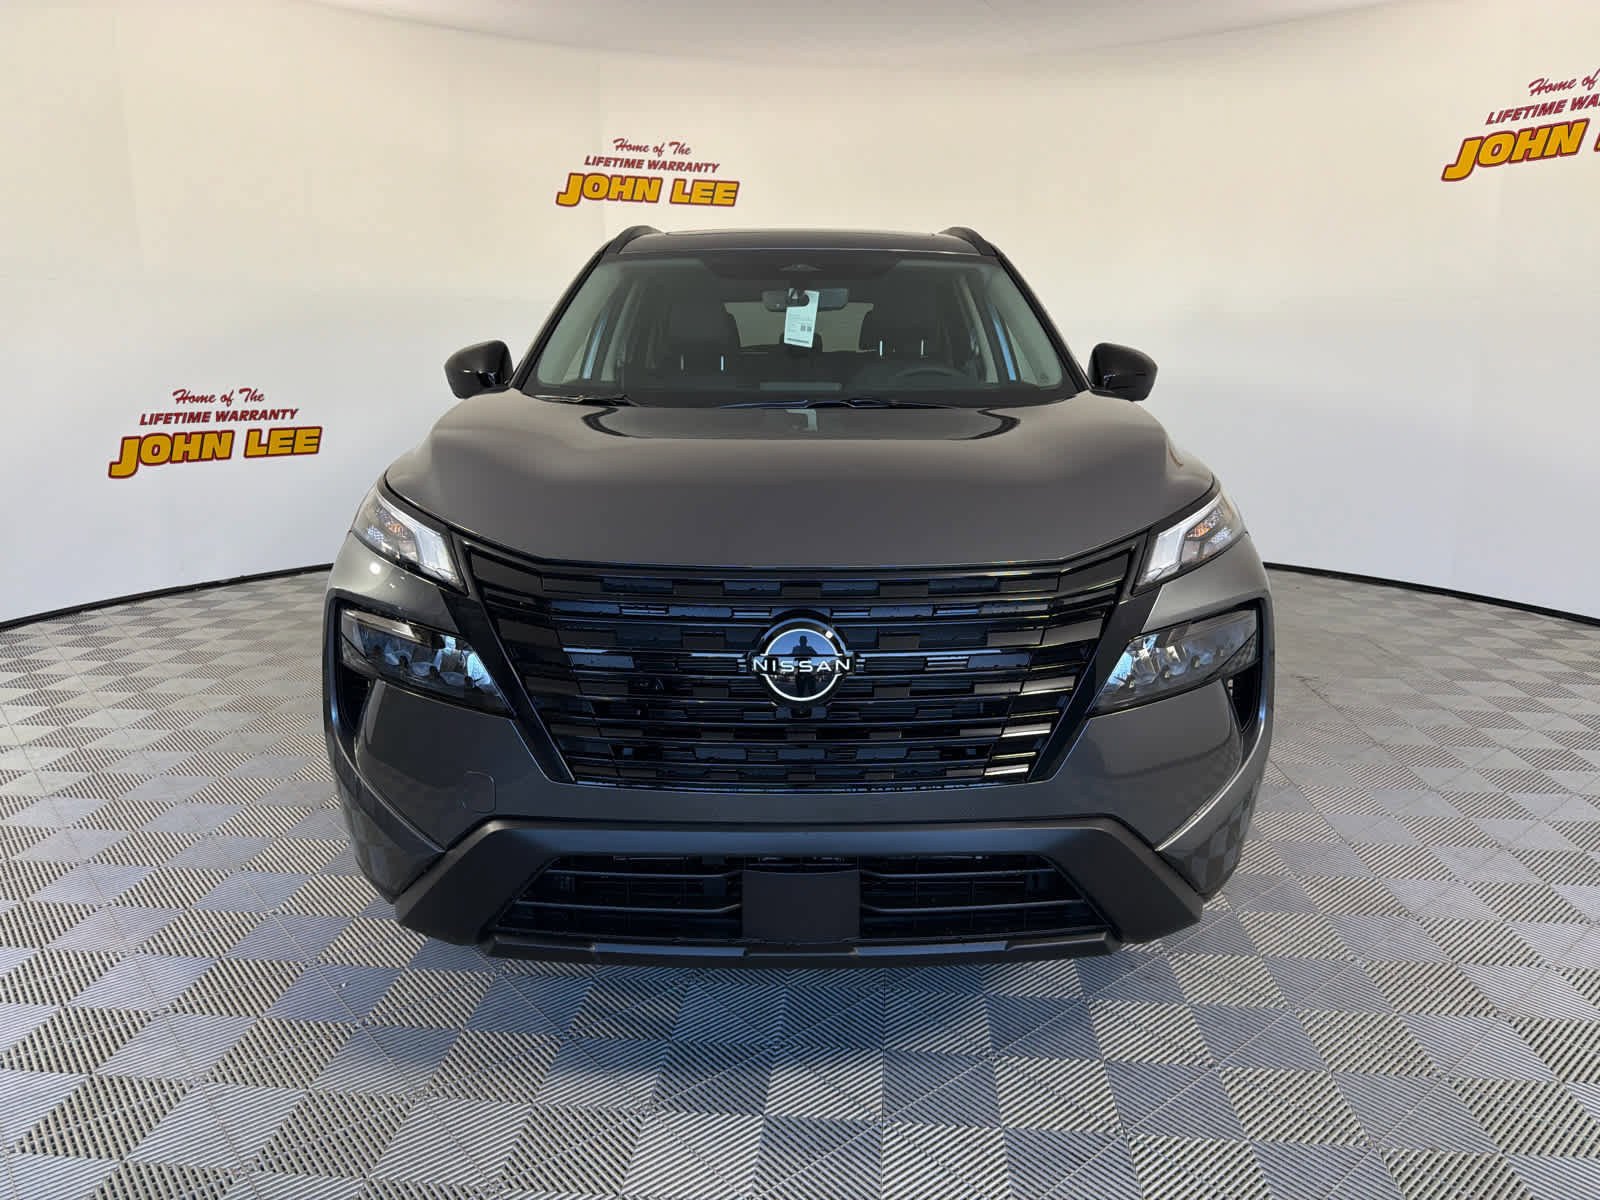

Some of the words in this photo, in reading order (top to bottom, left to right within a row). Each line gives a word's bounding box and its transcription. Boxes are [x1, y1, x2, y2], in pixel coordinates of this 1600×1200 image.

[1528, 78, 1577, 96] Home
[1486, 99, 1568, 125] LIFETIME
[613, 138, 650, 153] Home
[652, 142, 665, 157] of
[669, 141, 692, 155] The
[1441, 118, 1590, 182] JOHN
[584, 155, 645, 169] LIFETIME
[647, 160, 720, 173] WARRANTY
[556, 172, 663, 207] JOHN
[669, 178, 740, 207] LEE
[172, 389, 216, 404] Home
[220, 390, 234, 407] of
[238, 388, 265, 403] The
[139, 411, 212, 426] LIFETIME
[215, 408, 299, 423] WARRANTY
[108, 430, 235, 479] JOHN
[243, 426, 323, 458] LEE
[752, 658, 850, 673] NISSAN
